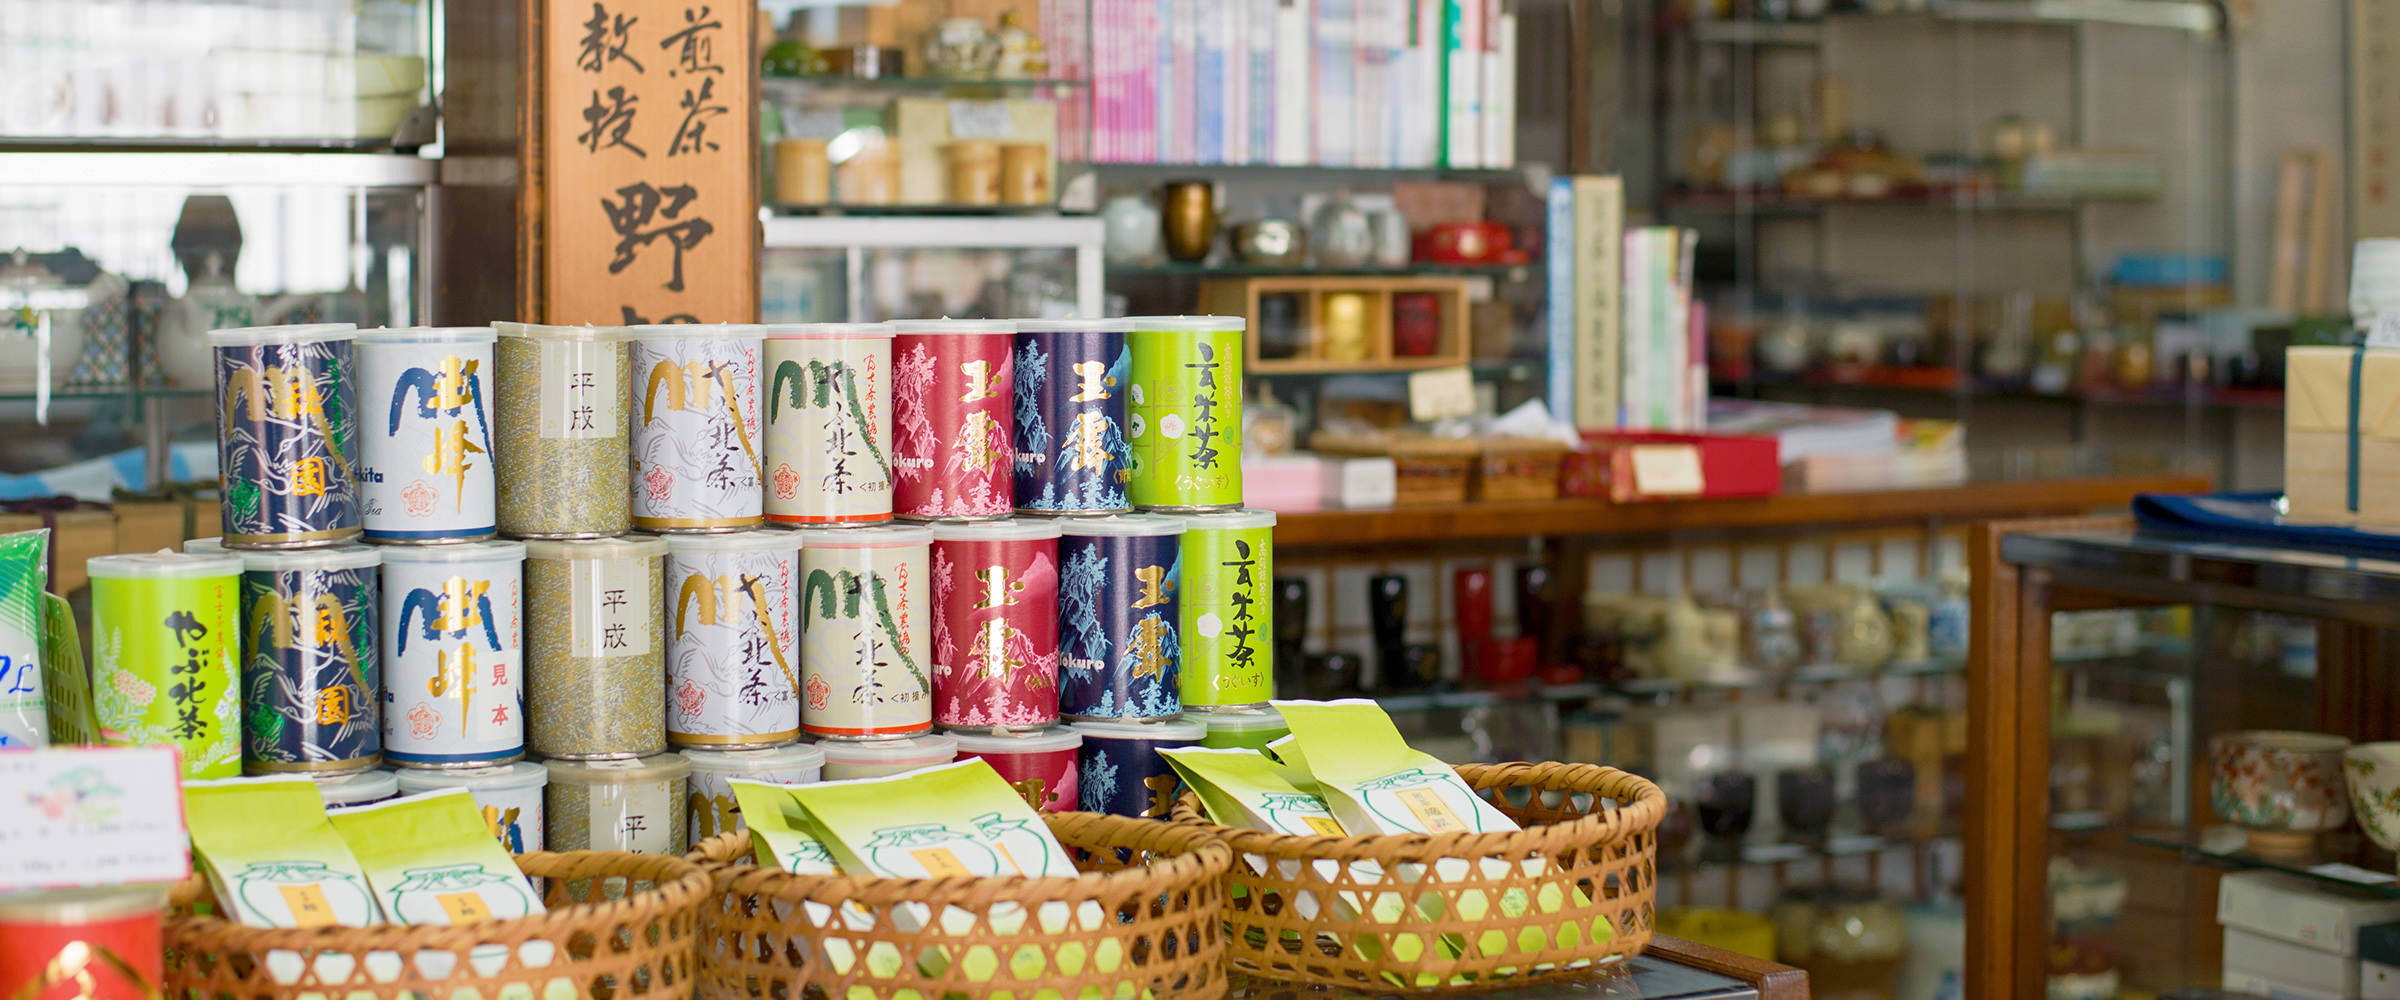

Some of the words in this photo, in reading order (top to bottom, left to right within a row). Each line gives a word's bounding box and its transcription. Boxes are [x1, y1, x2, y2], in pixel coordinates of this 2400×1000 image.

[577, 2, 647, 158] 教授
[659, 6, 728, 157] 煎茶
[601, 182, 714, 325] 野
[570, 371, 595, 431] 平成
[959, 360, 1002, 476] 玉露
[1062, 360, 1118, 476] 玉露
[1184, 342, 1220, 470] 玄米茶
[603, 589, 627, 649] 平成
[734, 572, 772, 706] やぶ北茶
[968, 566, 1026, 684] 玉露
[1124, 565, 1175, 683] 玉露
[1223, 539, 1255, 669] 玄米茶
[164, 610, 208, 740] やぶ北茶
[491, 664, 509, 726] 見本
